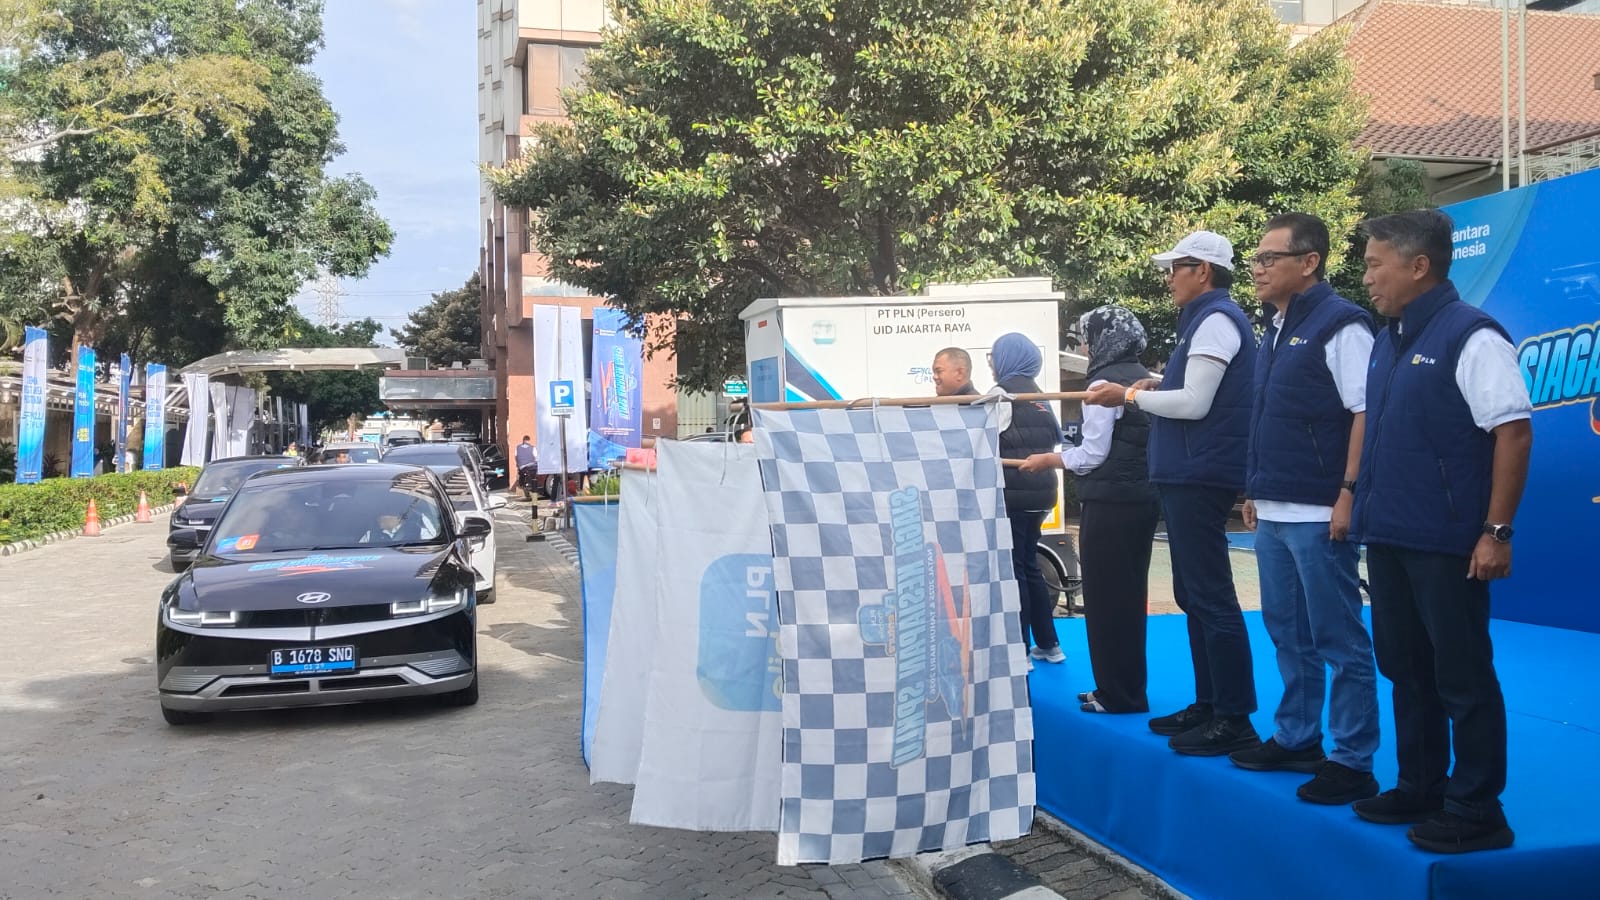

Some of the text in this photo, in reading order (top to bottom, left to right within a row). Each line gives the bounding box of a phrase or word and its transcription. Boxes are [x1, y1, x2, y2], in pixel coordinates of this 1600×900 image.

[1452, 224, 1490, 243] antara
[878, 307, 965, 319] PT PLN (Persero)
[873, 322, 972, 335] UID JAKARTA RAYA
[1420, 356, 1436, 365] PLN
[907, 367, 933, 375] SPKL
[554, 385, 570, 403] P
[274, 651, 283, 666] B
[289, 648, 322, 665] 1678
